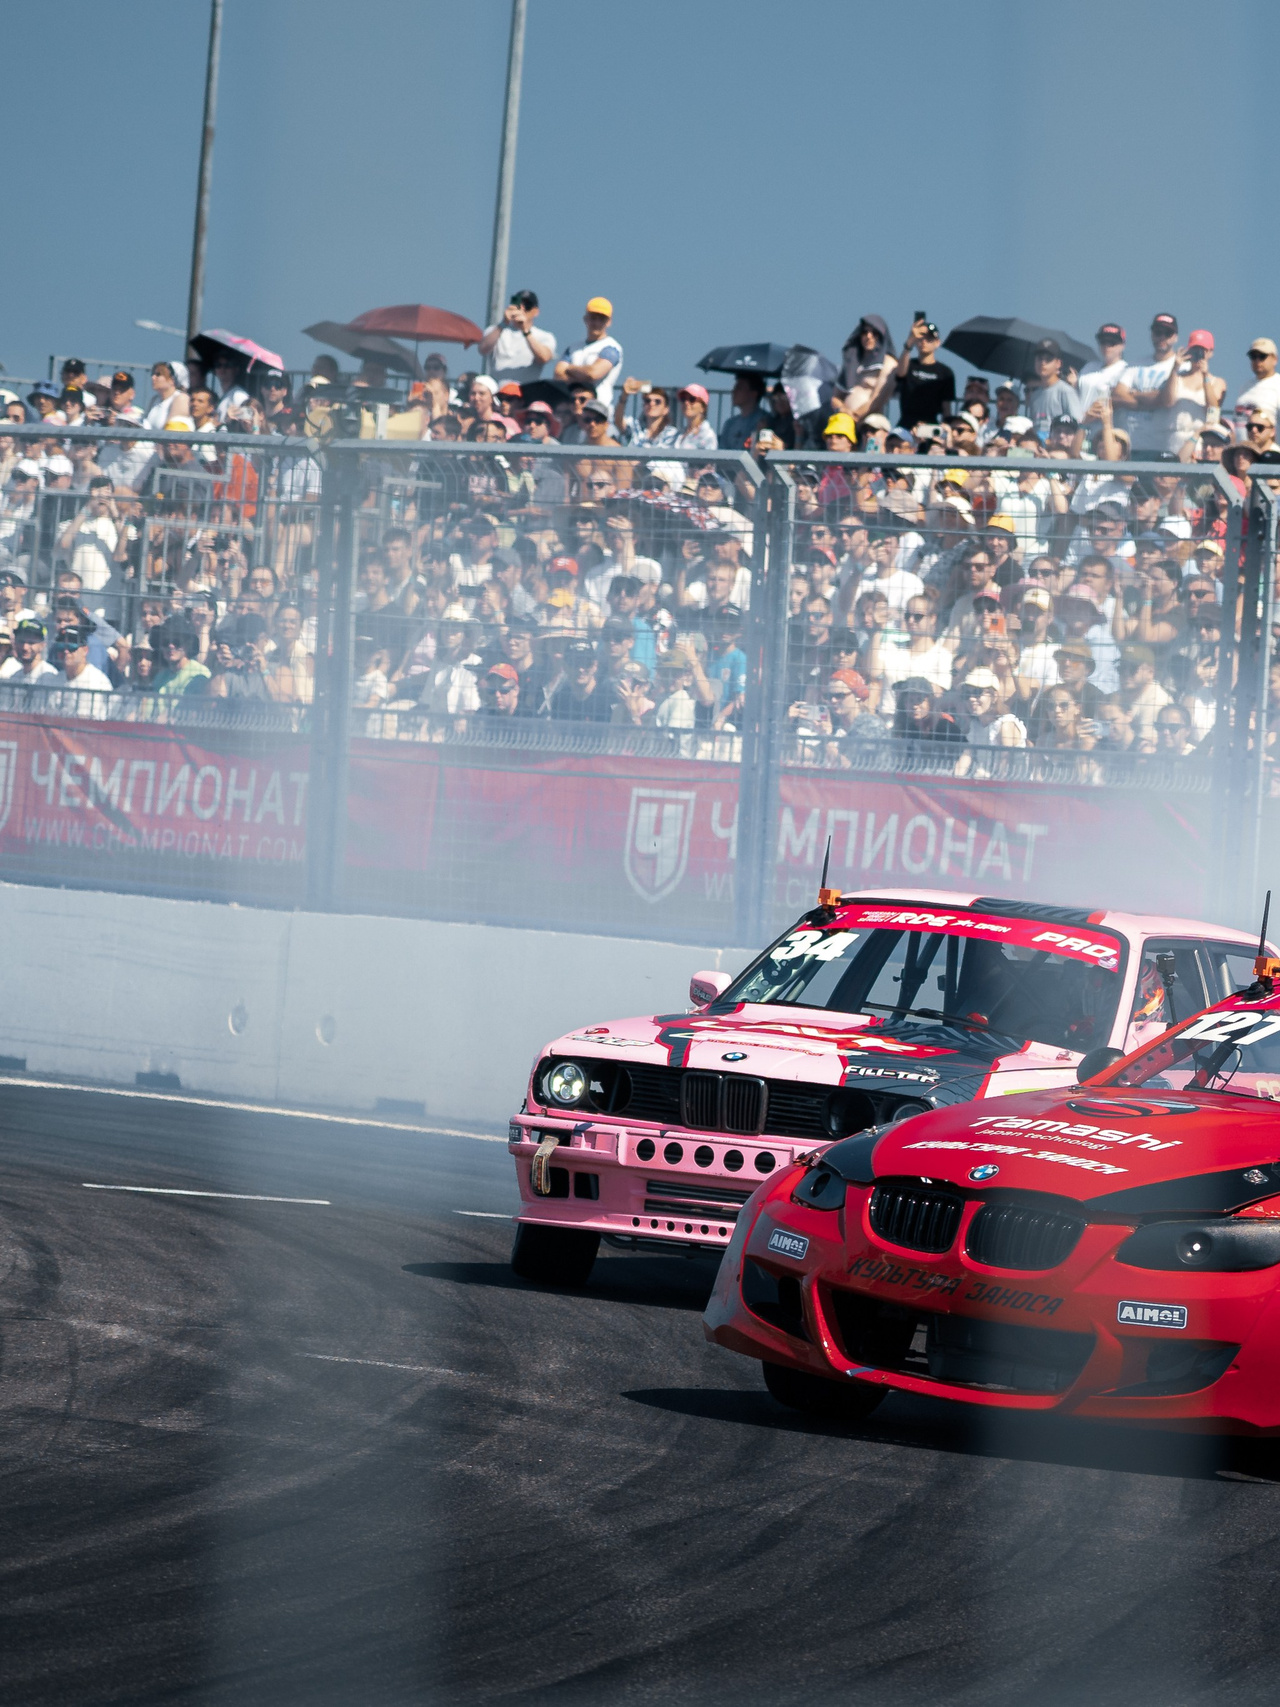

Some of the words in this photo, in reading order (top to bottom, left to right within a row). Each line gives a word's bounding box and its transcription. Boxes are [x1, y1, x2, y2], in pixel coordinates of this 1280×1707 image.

[31, 751, 309, 826] ЧЕМПИОНАТ
[711, 801, 1049, 882] ЧМПИОНАТ
[769, 928, 861, 963] 34
[890, 911, 957, 927] RDS
[974, 922, 1011, 934] OPEN
[1032, 931, 1118, 958] PRO
[968, 1115, 1184, 1151] Tamashi
[1023, 1133, 1113, 1151] technology
[1022, 1151, 1129, 1175] ЗАНОСА
[770, 1233, 804, 1254] AIMOL
[847, 1257, 964, 1296] КУЛЬТУРА
[965, 1282, 1064, 1315] ЗАНОСА
[1120, 1306, 1184, 1323] AIMOL
